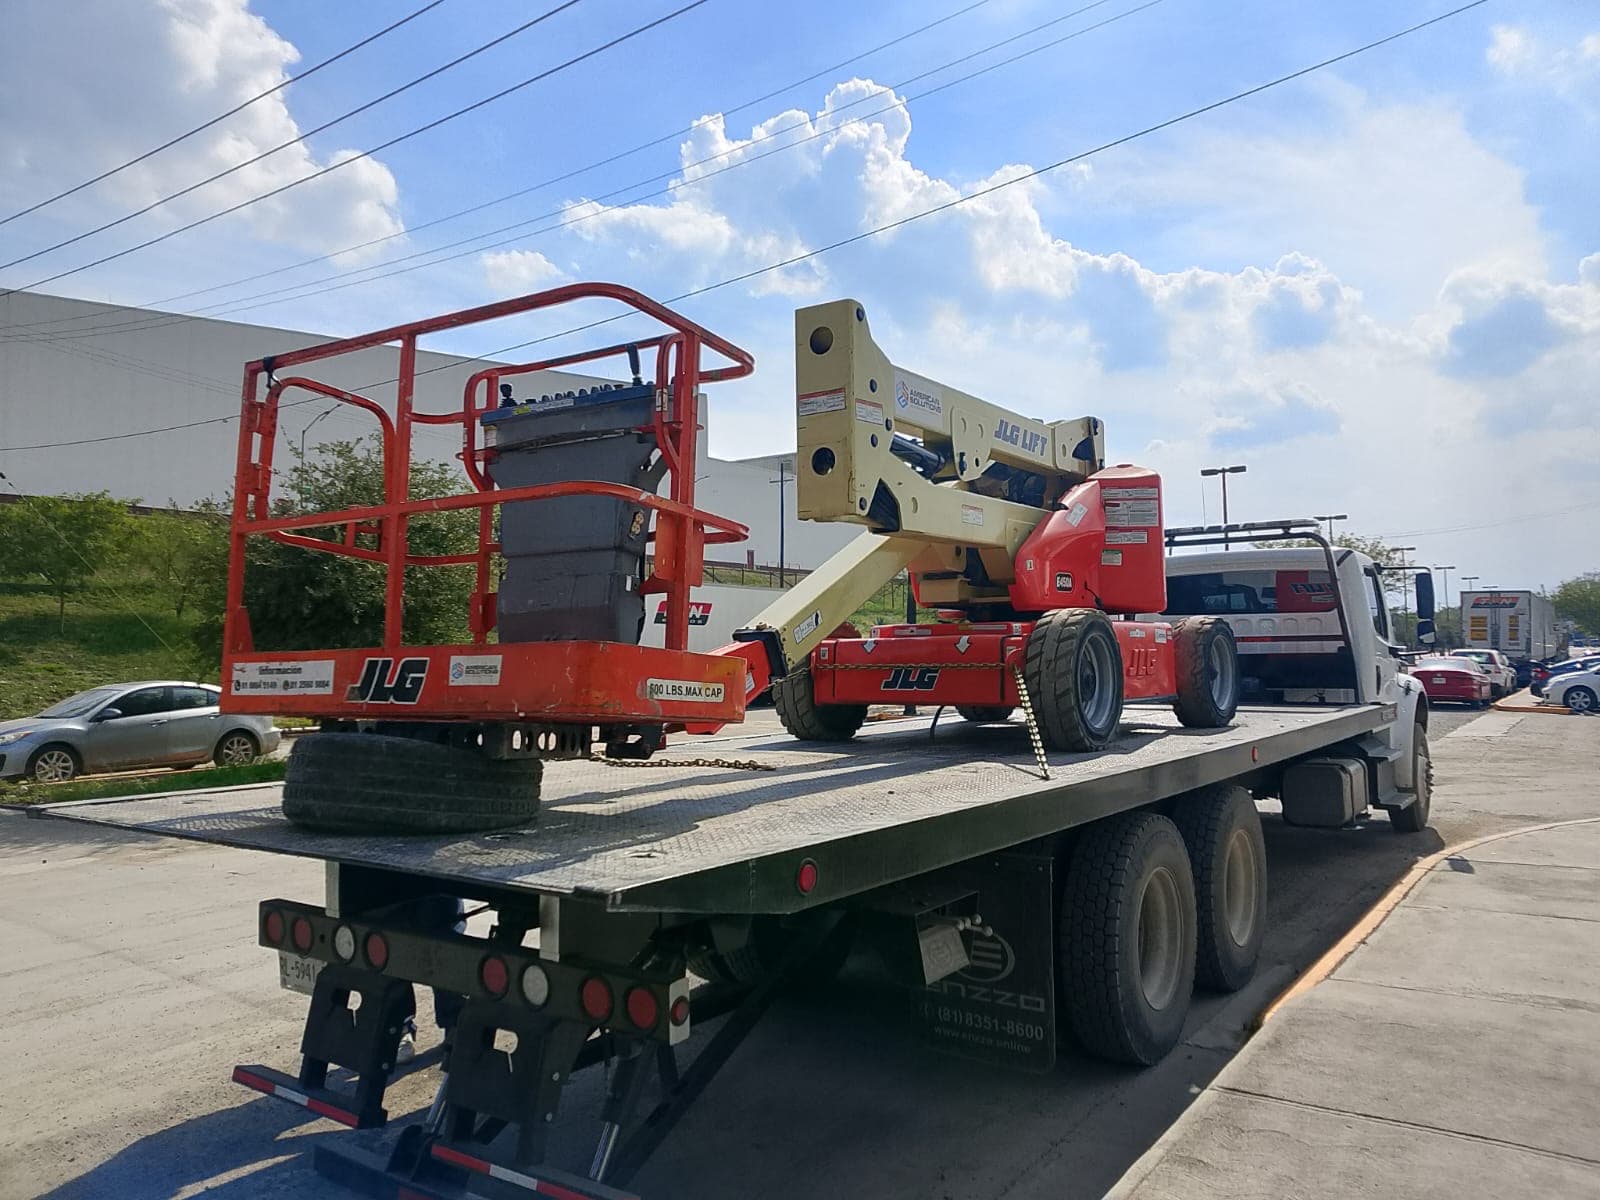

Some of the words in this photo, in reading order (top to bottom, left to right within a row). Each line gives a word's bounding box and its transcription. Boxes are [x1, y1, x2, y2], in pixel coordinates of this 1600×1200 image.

[909, 396, 942, 414] SOLUTIONS
[910, 388, 940, 406] AMERICAN
[993, 417, 1020, 447] JLG
[1021, 428, 1048, 457] LIFT
[345, 657, 431, 705] JLG
[649, 683, 664, 696] 500
[704, 687, 722, 698] CAP
[880, 667, 941, 691] JLG
[938, 1006, 962, 1025] (81)
[965, 1012, 1045, 1041] 8351-8600
